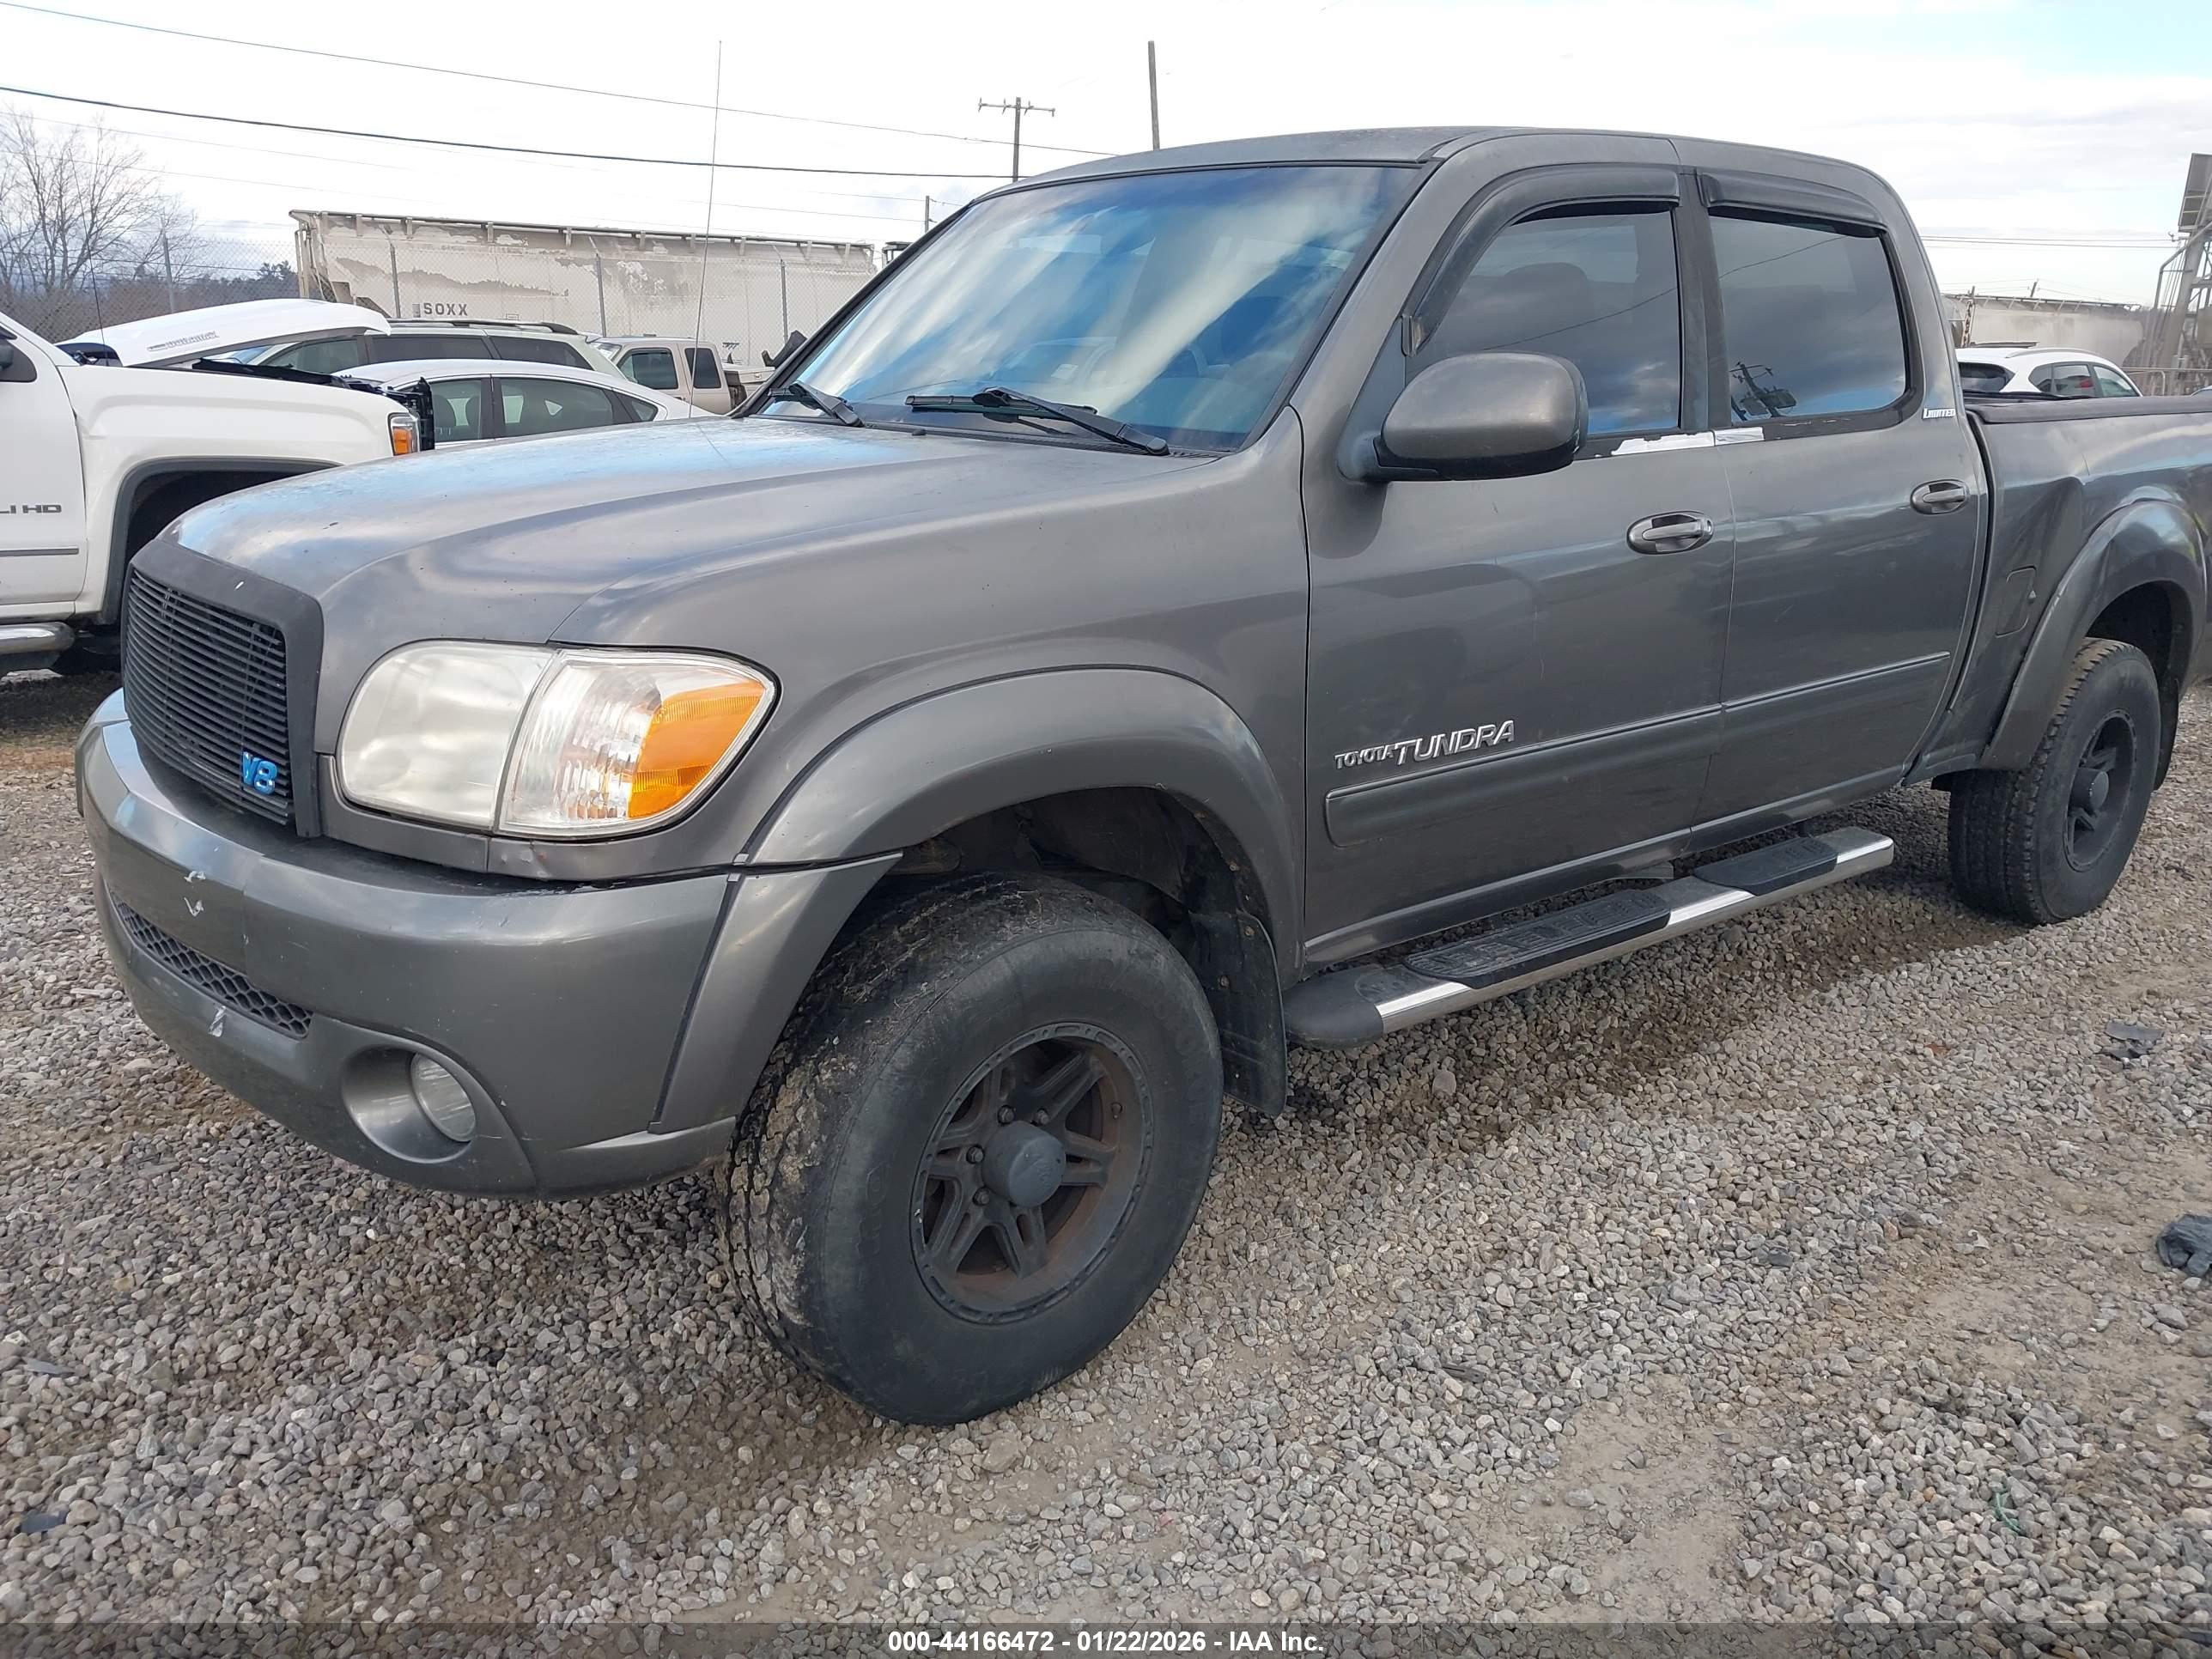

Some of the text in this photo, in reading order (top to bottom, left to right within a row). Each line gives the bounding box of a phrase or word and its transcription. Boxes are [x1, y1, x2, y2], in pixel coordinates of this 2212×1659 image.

[22, 504, 62, 514] HD
[1334, 720, 1515, 769] TOYOTA TUNDRA
[242, 751, 277, 794] V8
